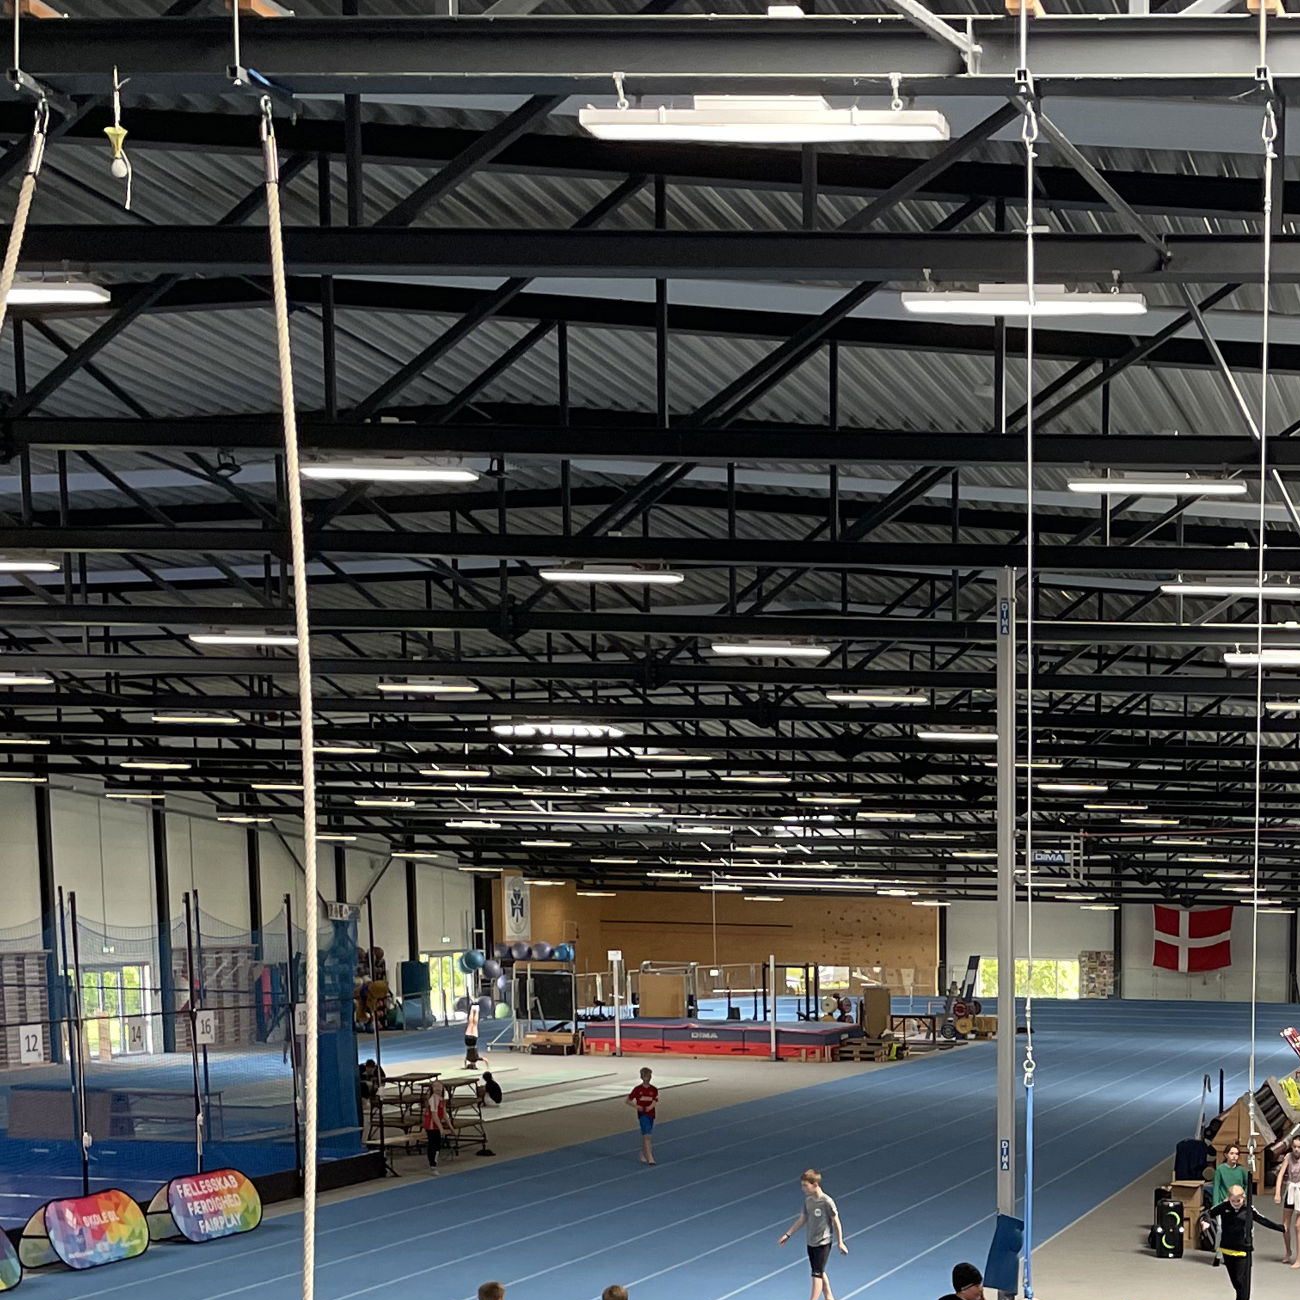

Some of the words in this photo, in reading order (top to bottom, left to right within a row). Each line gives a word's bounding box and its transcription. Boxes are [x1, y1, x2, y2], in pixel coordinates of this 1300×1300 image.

[1001, 602, 1009, 634] DIMA
[1035, 853, 1064, 862] DIMA
[131, 1027, 142, 1043] 14
[200, 1019, 212, 1036] 16
[24, 1034, 38, 1053] 12
[176, 1175, 238, 1198] FÆLLESSKAB
[187, 1193, 242, 1216] FÆRDIGHED
[198, 1212, 242, 1234] FAIRPLAY
